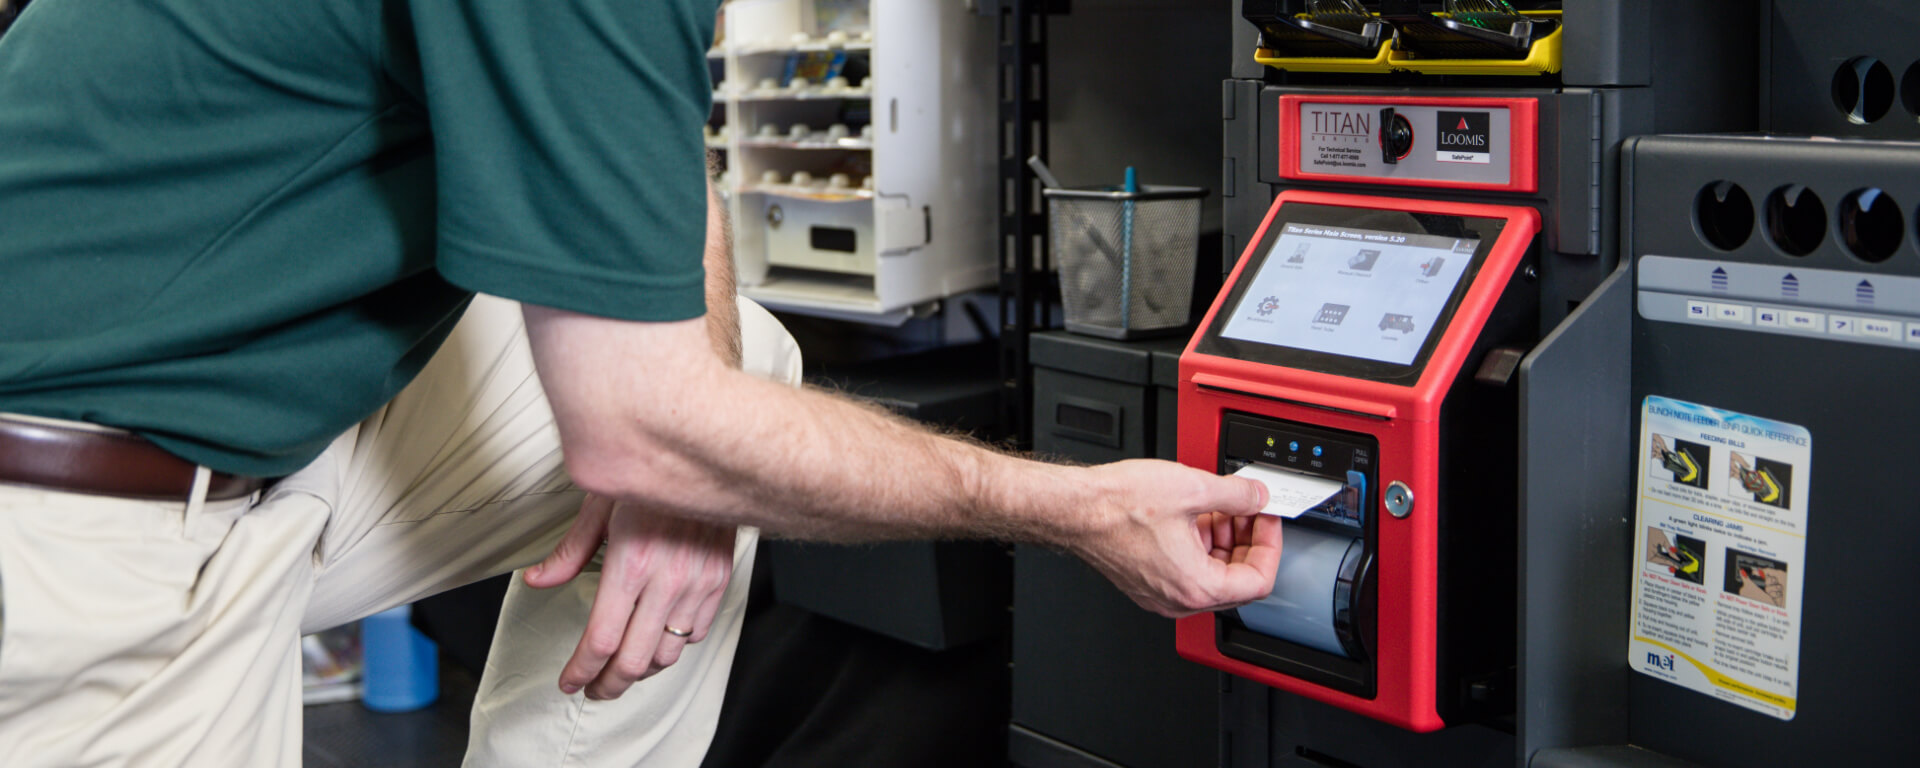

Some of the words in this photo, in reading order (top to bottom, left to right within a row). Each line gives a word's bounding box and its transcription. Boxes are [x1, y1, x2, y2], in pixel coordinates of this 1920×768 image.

[1311, 111, 1369, 134] TITAN
[1441, 131, 1485, 146] LOOMIS
[1692, 306, 1703, 314] 5
[1835, 320, 1846, 329] 7
[1649, 405, 1672, 418] BUNCH
[1673, 411, 1692, 422] NOTE
[1693, 415, 1720, 428] FEEDER
[1742, 426, 1763, 438] QUICK
[1766, 431, 1807, 448] REFERENCE
[1700, 434, 1727, 445] FEEDING
[1728, 440, 1745, 449] BILLS
[1263, 450, 1276, 458] PAPER
[1693, 514, 1724, 527] CLEARING
[1725, 522, 1744, 532] JAMS
[1647, 652, 1674, 671] mei
